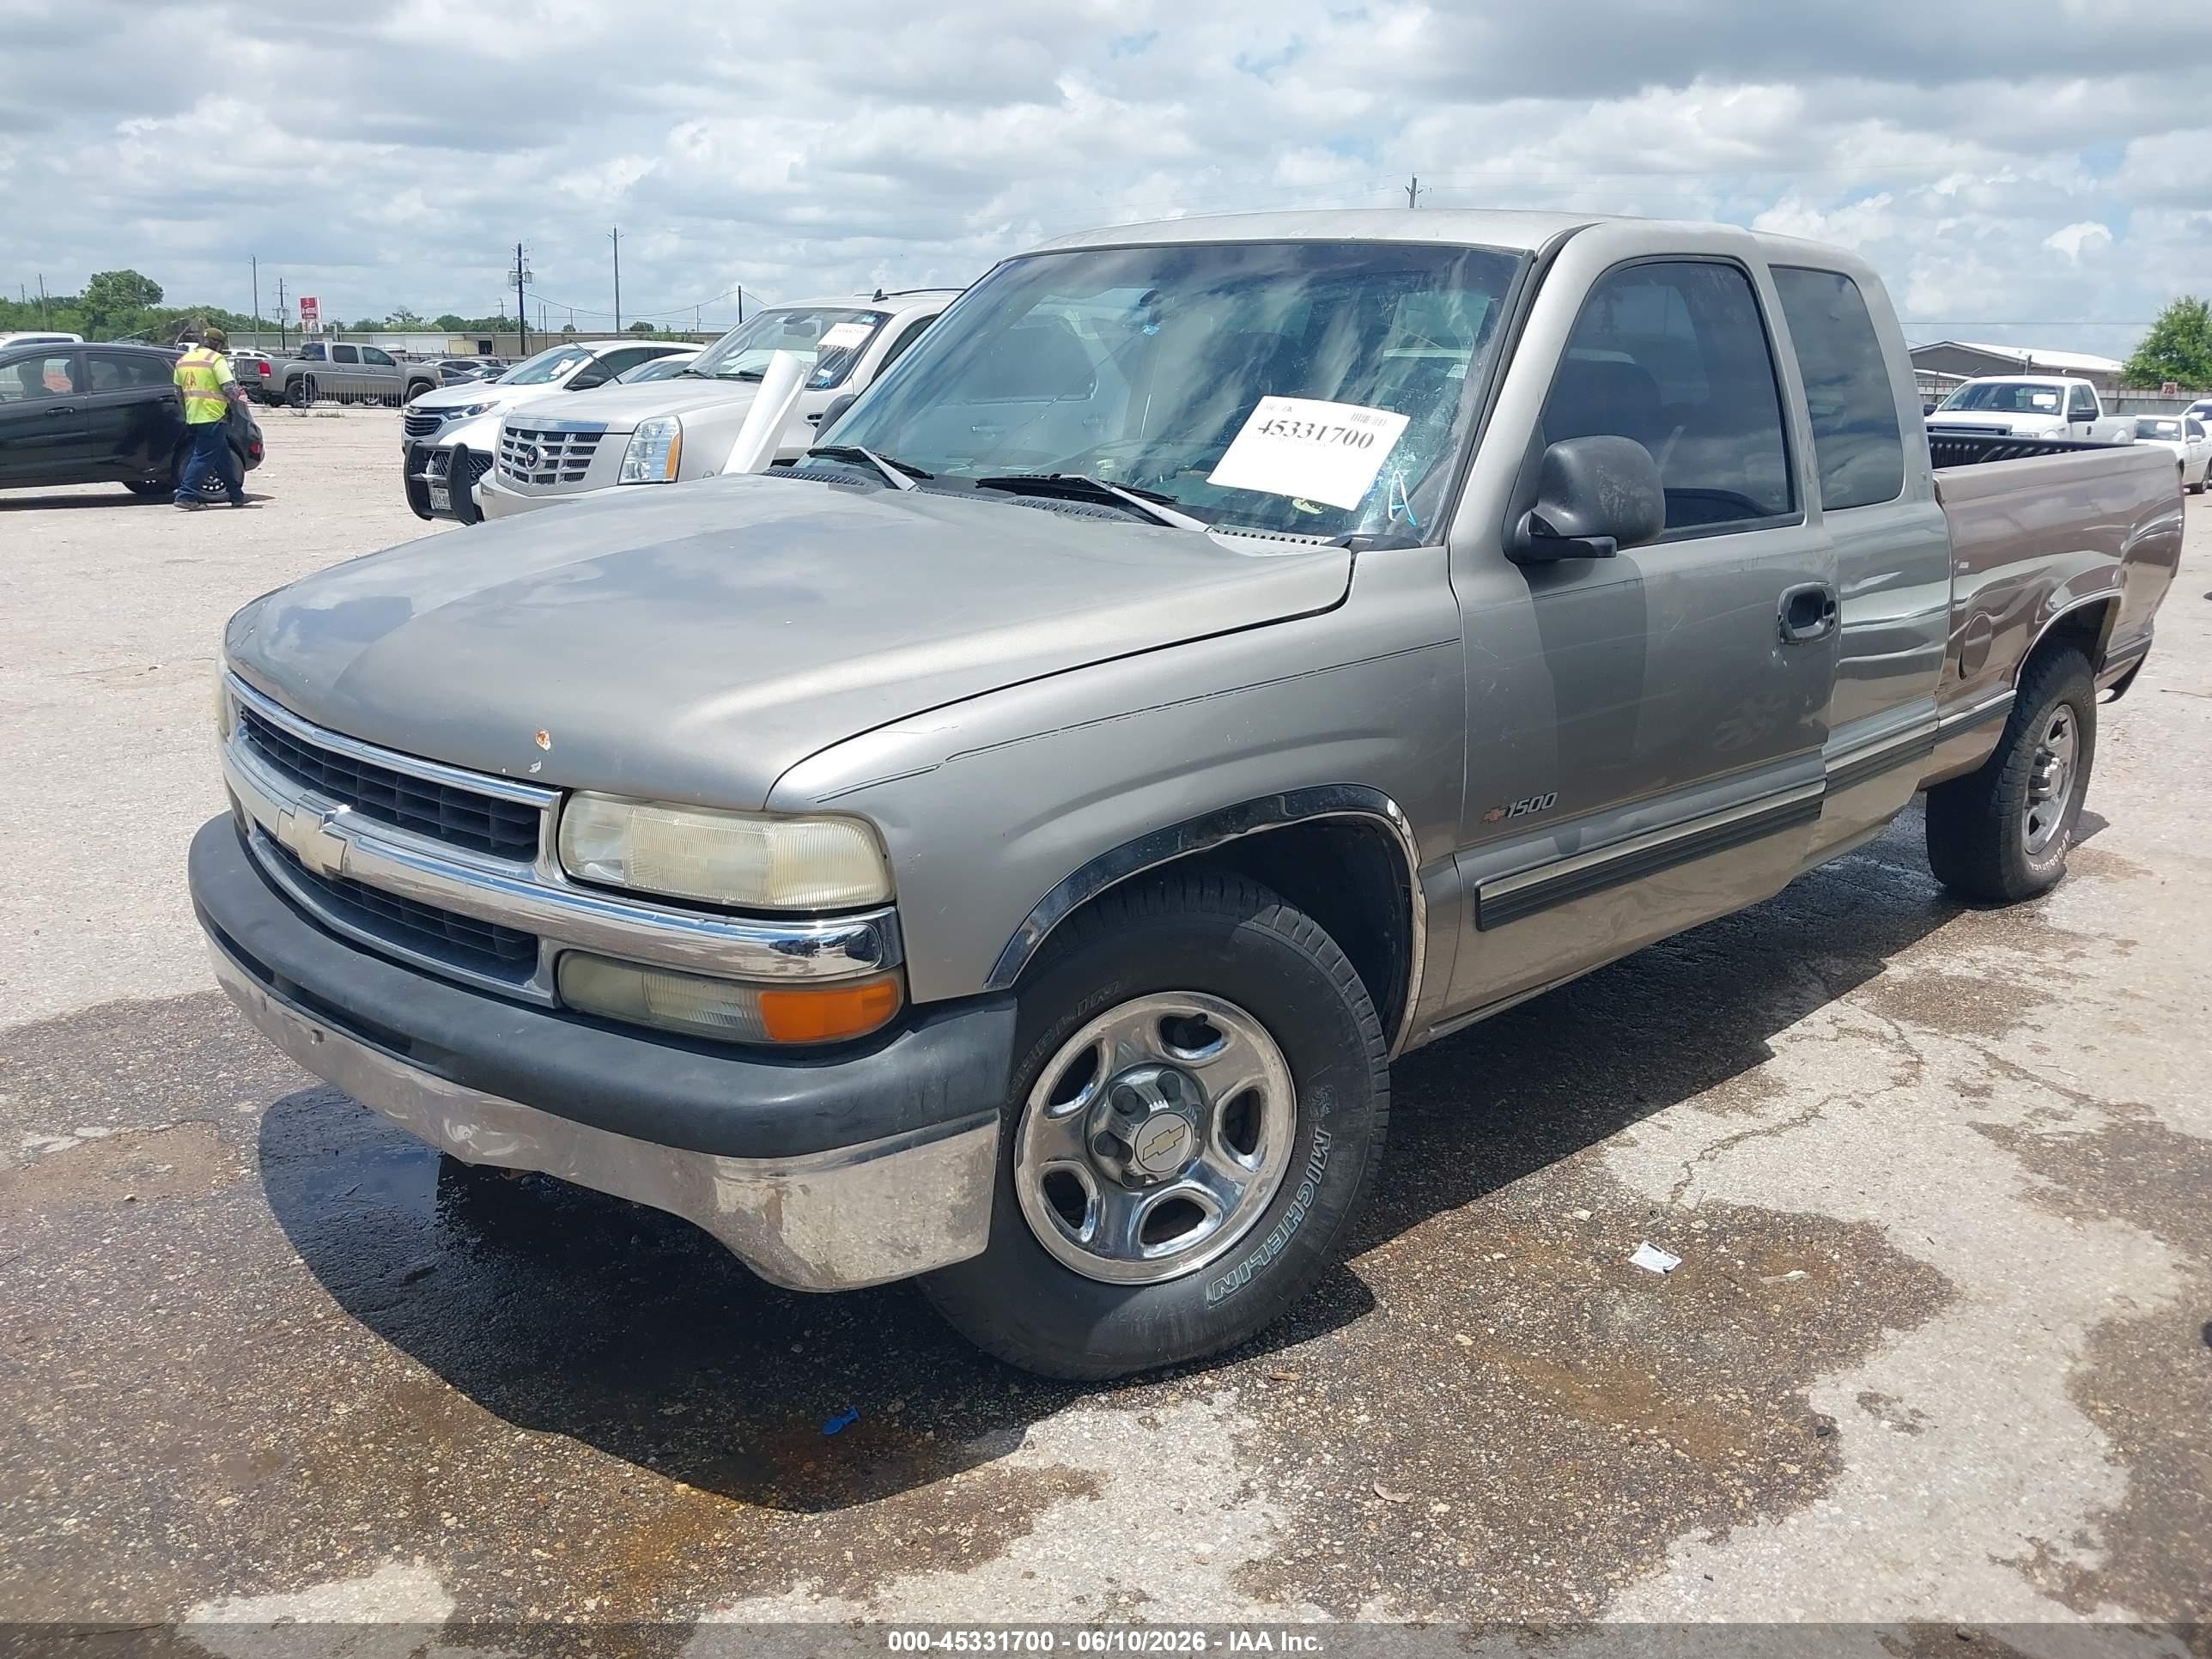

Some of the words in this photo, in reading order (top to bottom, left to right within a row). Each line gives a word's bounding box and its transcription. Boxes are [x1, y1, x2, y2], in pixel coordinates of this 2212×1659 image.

[1257, 418, 1375, 449] 45331700
[1507, 791, 1559, 818] 1500
[1210, 1127, 1333, 1303] MICHELIN
